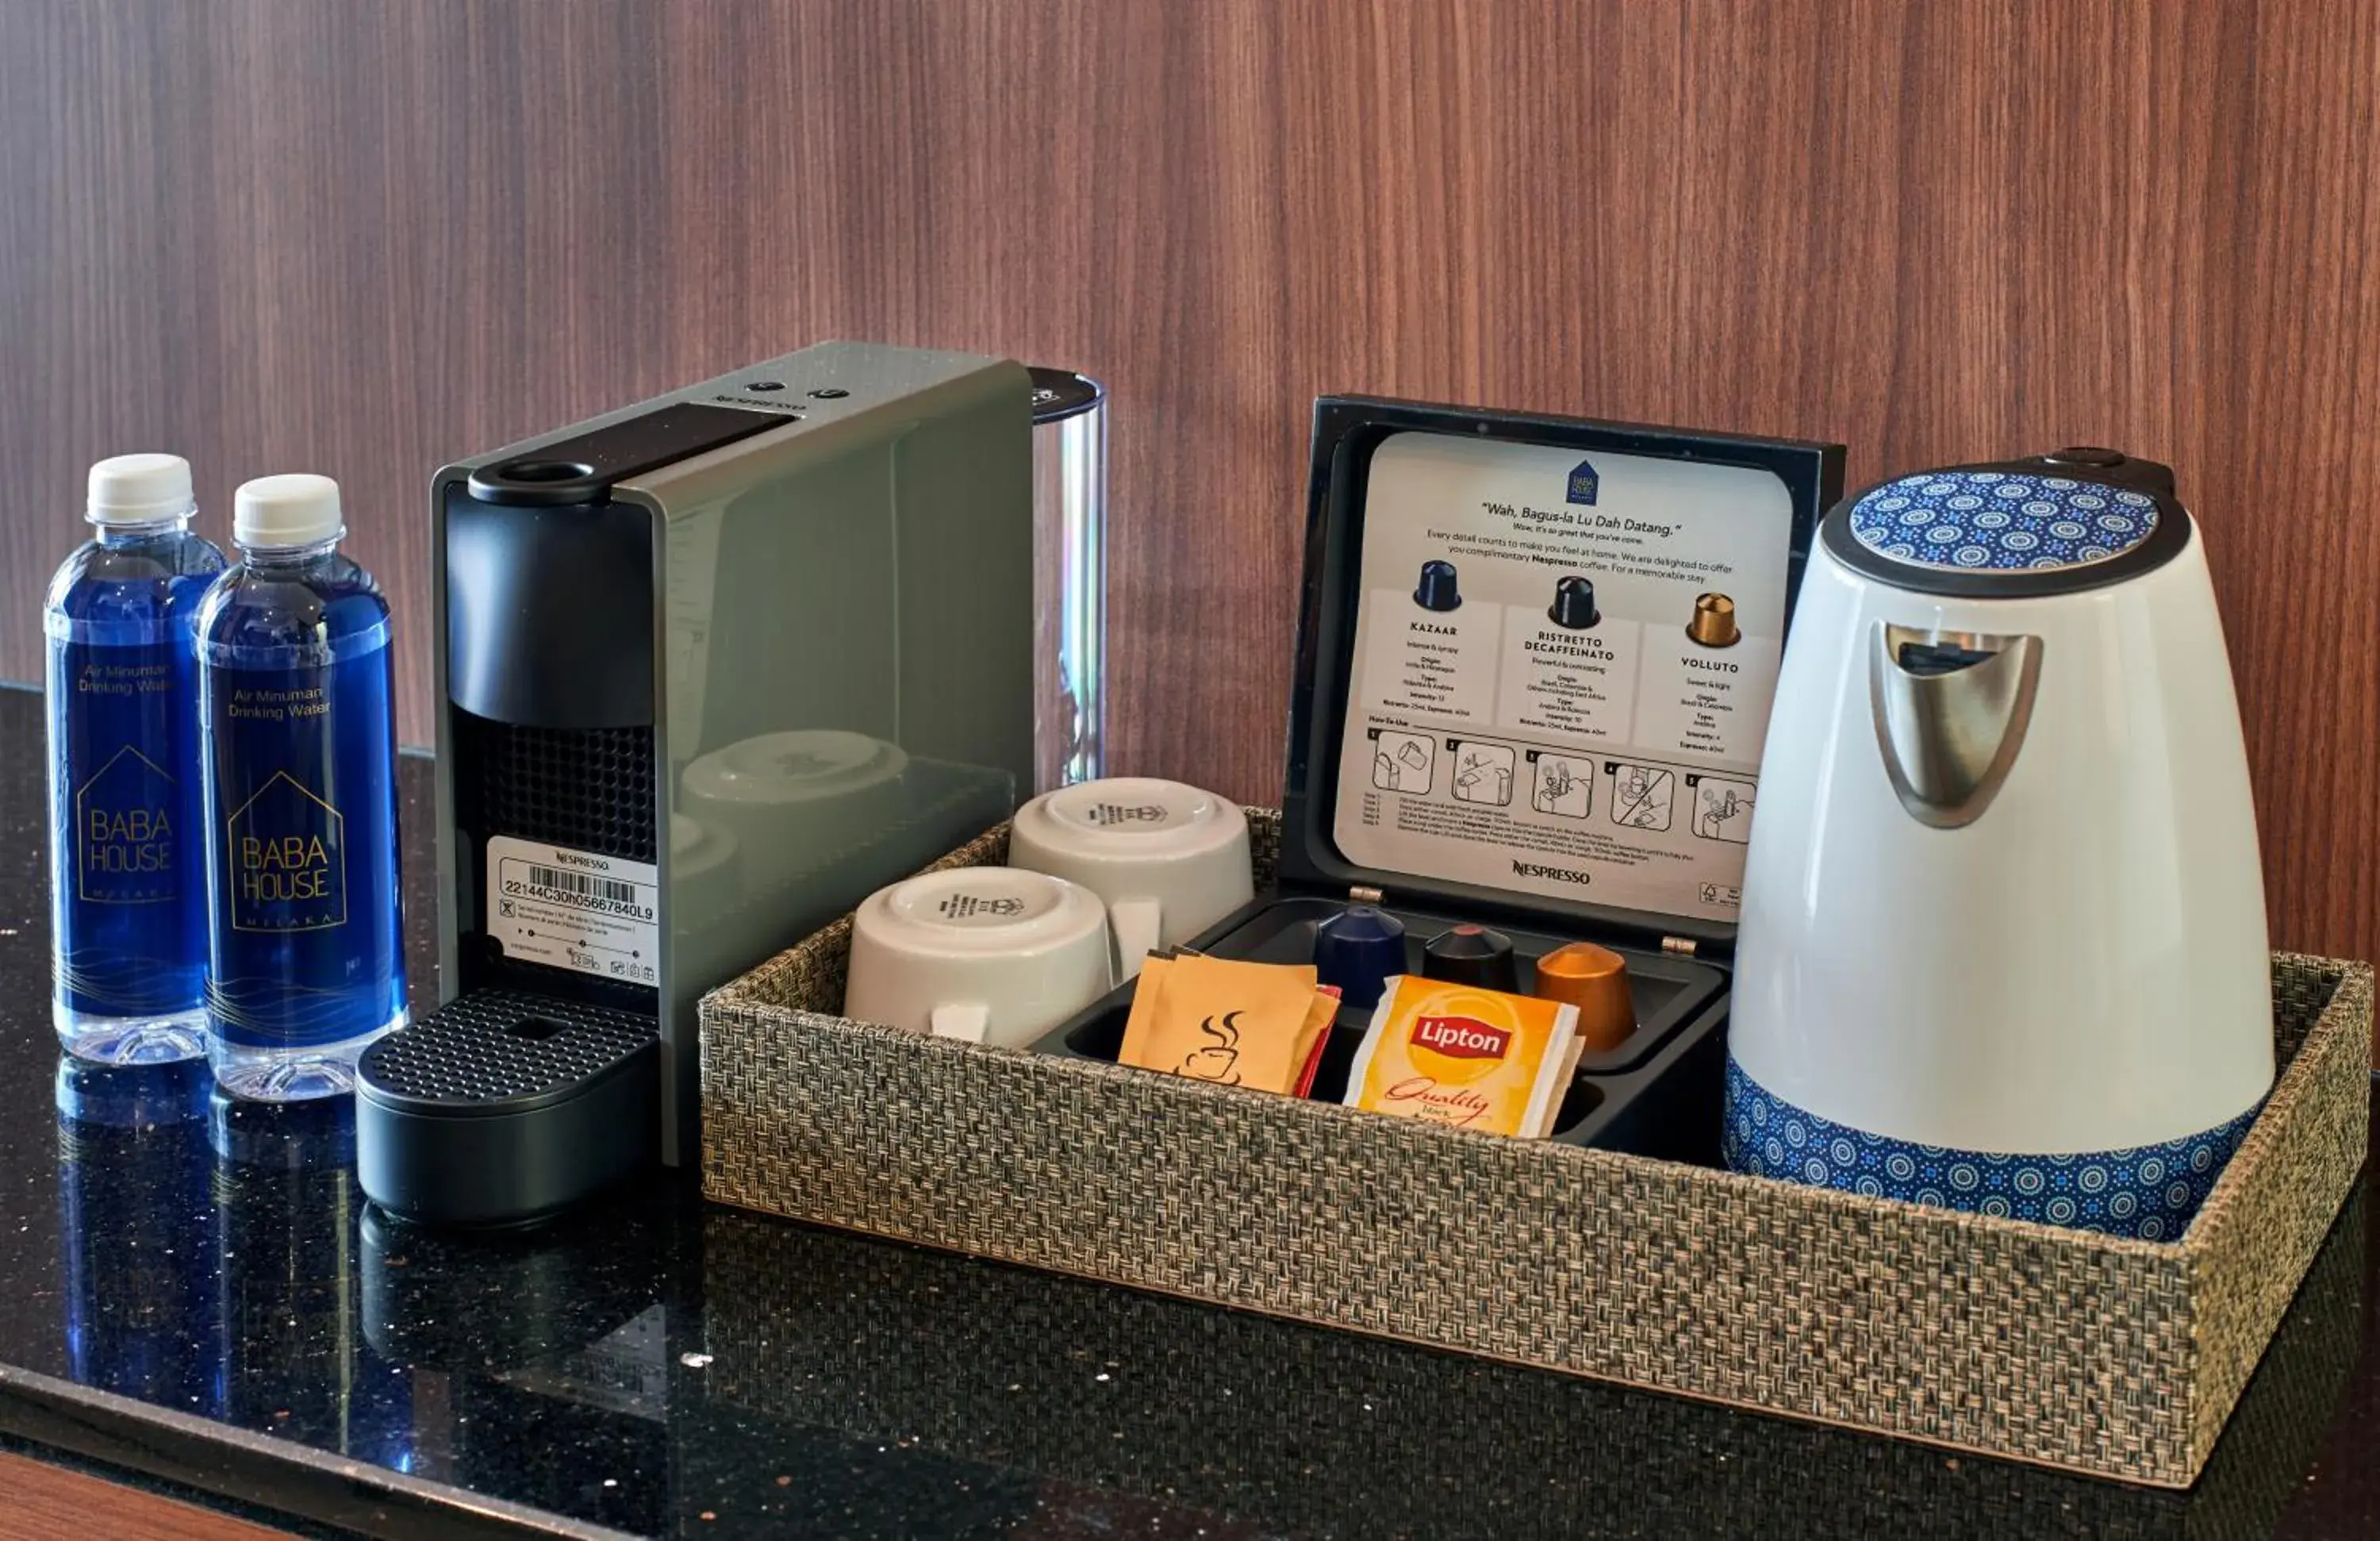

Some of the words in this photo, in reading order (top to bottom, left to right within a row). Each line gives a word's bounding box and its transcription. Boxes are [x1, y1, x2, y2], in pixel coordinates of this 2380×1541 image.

[1522, 507, 1573, 525] Bagus-la
[1577, 513, 1592, 526] Lu
[1595, 515, 1621, 529] Dah
[1558, 529, 1578, 538] great
[1580, 531, 1594, 540] that
[1427, 528, 1450, 540] Every
[1453, 532, 1476, 544] detail
[1478, 536, 1506, 548] counts
[1508, 540, 1518, 548] to
[1519, 540, 1543, 551] make
[1545, 544, 1560, 554] you
[1562, 544, 1580, 555] feel
[1621, 552, 1637, 562] We
[1637, 555, 1653, 565] are
[1654, 557, 1697, 571] delighted
[1699, 563, 1708, 571] to
[1710, 563, 1733, 574] offer
[1449, 546, 1465, 555] you
[1532, 555, 1578, 568] Nespresso
[1612, 563, 1626, 573] For
[1635, 567, 1685, 581] memorable
[1410, 621, 1459, 636] KAZAAR
[1538, 631, 1603, 648] RISTRETTO
[1524, 640, 1614, 661] DECAFFEINATO
[1681, 656, 1738, 673] VOLLUTO
[136, 678, 171, 693] Wat
[234, 689, 255, 702] Air
[257, 688, 323, 702] Minuman
[228, 703, 283, 721] Drinking
[289, 701, 331, 718] Water
[90, 809, 172, 842] BABA
[90, 841, 171, 872] HOUSE
[243, 835, 328, 870] BABA
[555, 850, 609, 870] NESPRESSO
[1512, 859, 1591, 886] NESPRESSO
[244, 869, 330, 901] HOUSE
[1421, 1021, 1502, 1052] Lipton
[1384, 1076, 1490, 1119] Quality
